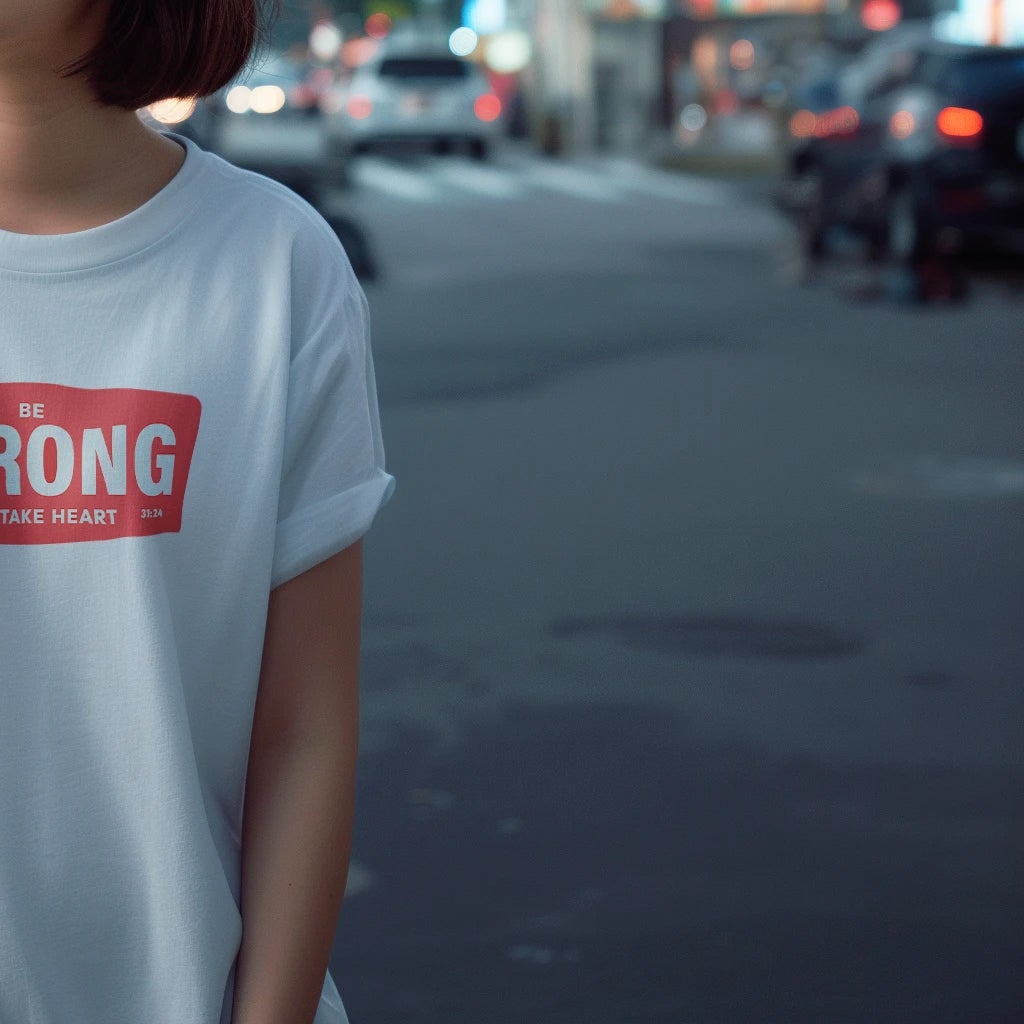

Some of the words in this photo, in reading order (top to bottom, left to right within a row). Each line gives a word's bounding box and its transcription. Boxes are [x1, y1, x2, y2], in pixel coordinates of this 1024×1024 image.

[19, 402, 45, 419] BE
[0, 508, 45, 525] TAKE
[51, 508, 118, 525] HEART
[140, 508, 163, 519] 31:24
